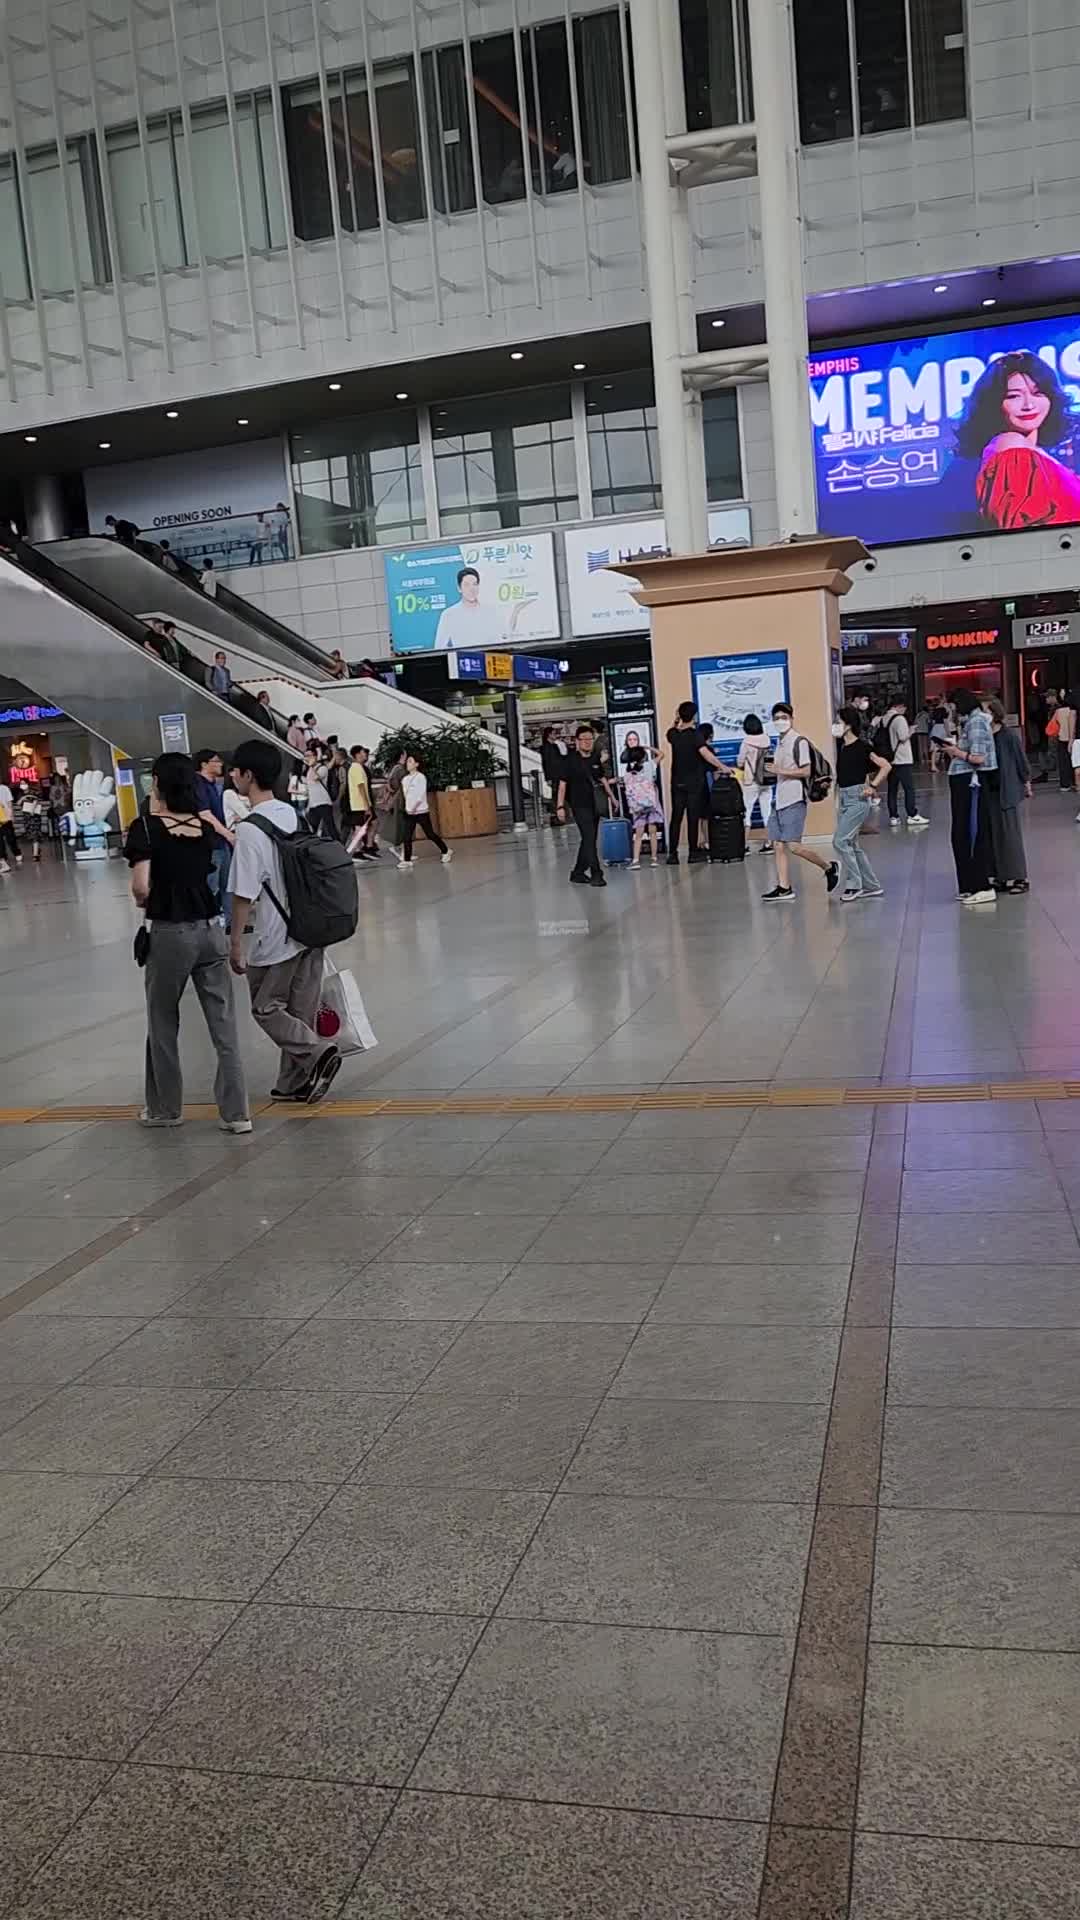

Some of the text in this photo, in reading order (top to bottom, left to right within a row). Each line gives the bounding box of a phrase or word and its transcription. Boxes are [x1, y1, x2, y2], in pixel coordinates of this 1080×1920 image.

[826, 448, 940, 493] 손승연
[153, 505, 232, 527] OPENING SOON
[395, 593, 430, 615] 10%
